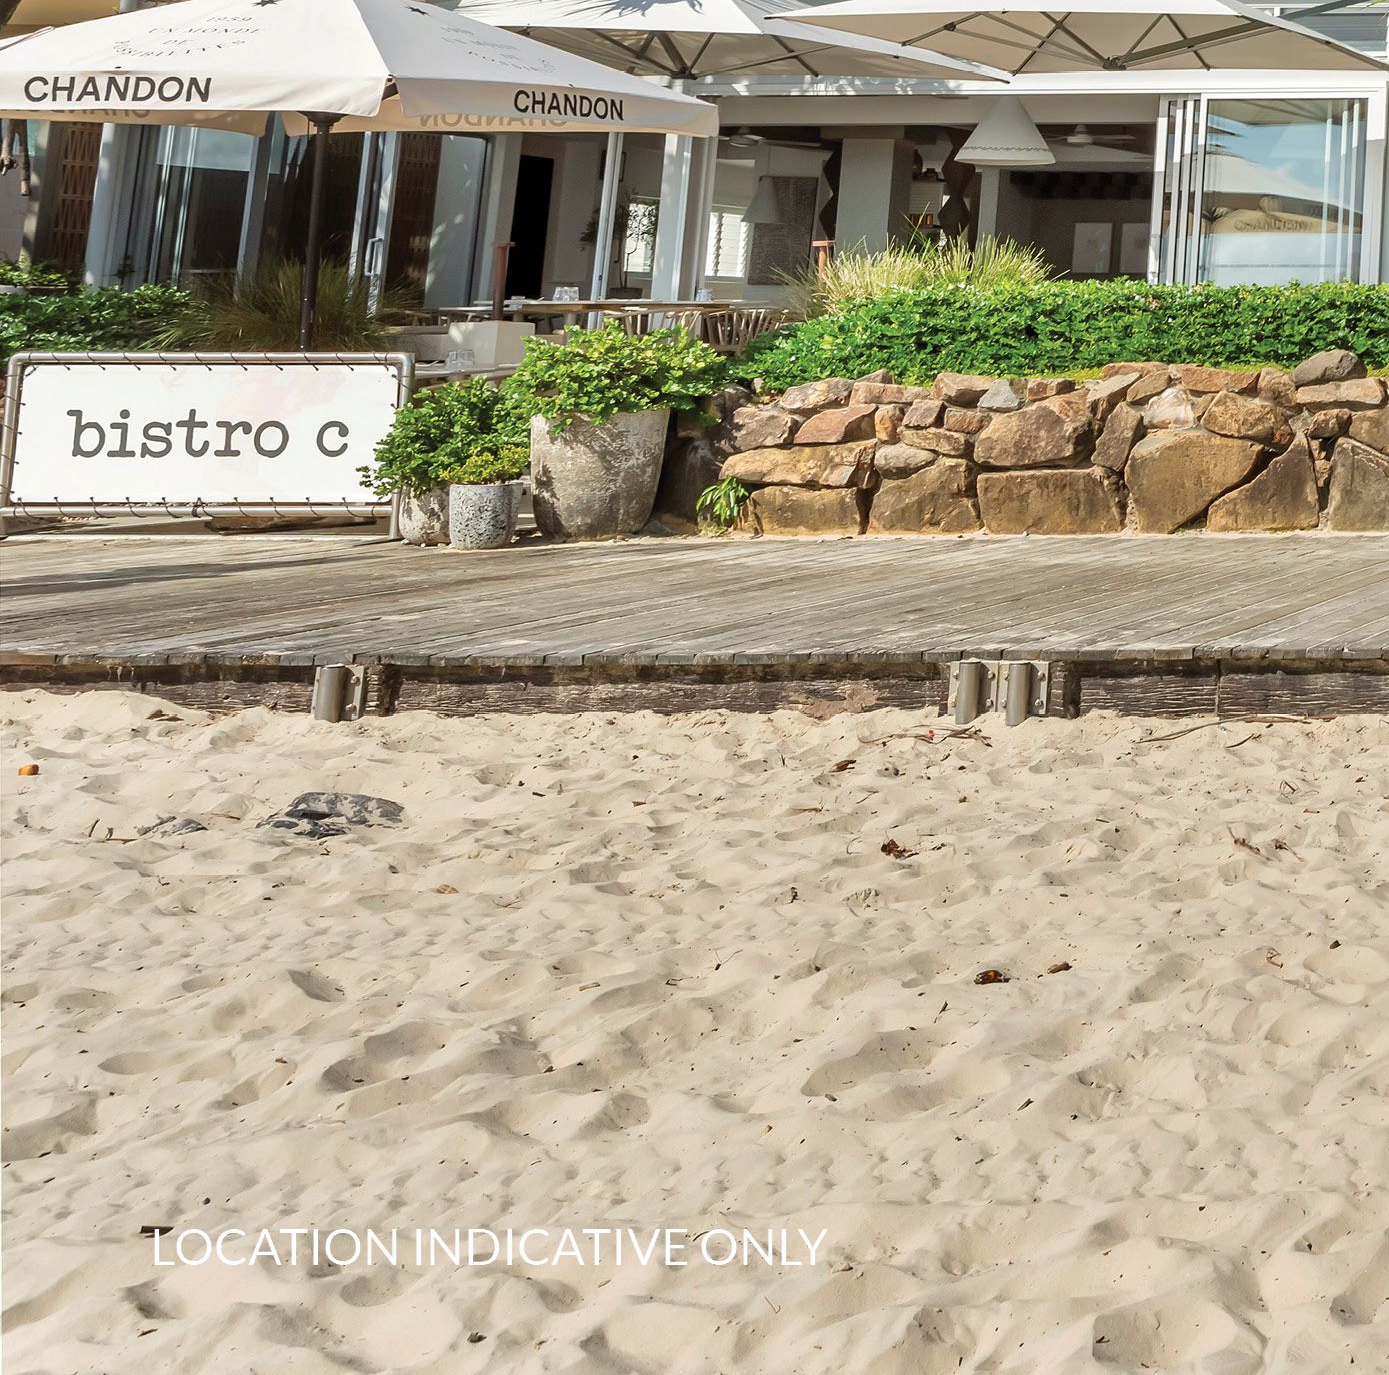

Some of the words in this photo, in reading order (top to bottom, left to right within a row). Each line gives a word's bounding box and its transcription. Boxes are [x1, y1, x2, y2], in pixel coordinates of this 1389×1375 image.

[24, 76, 212, 103] CHANDON
[514, 89, 625, 121] CHANDON
[67, 409, 289, 458] bistro
[316, 421, 349, 457] c
